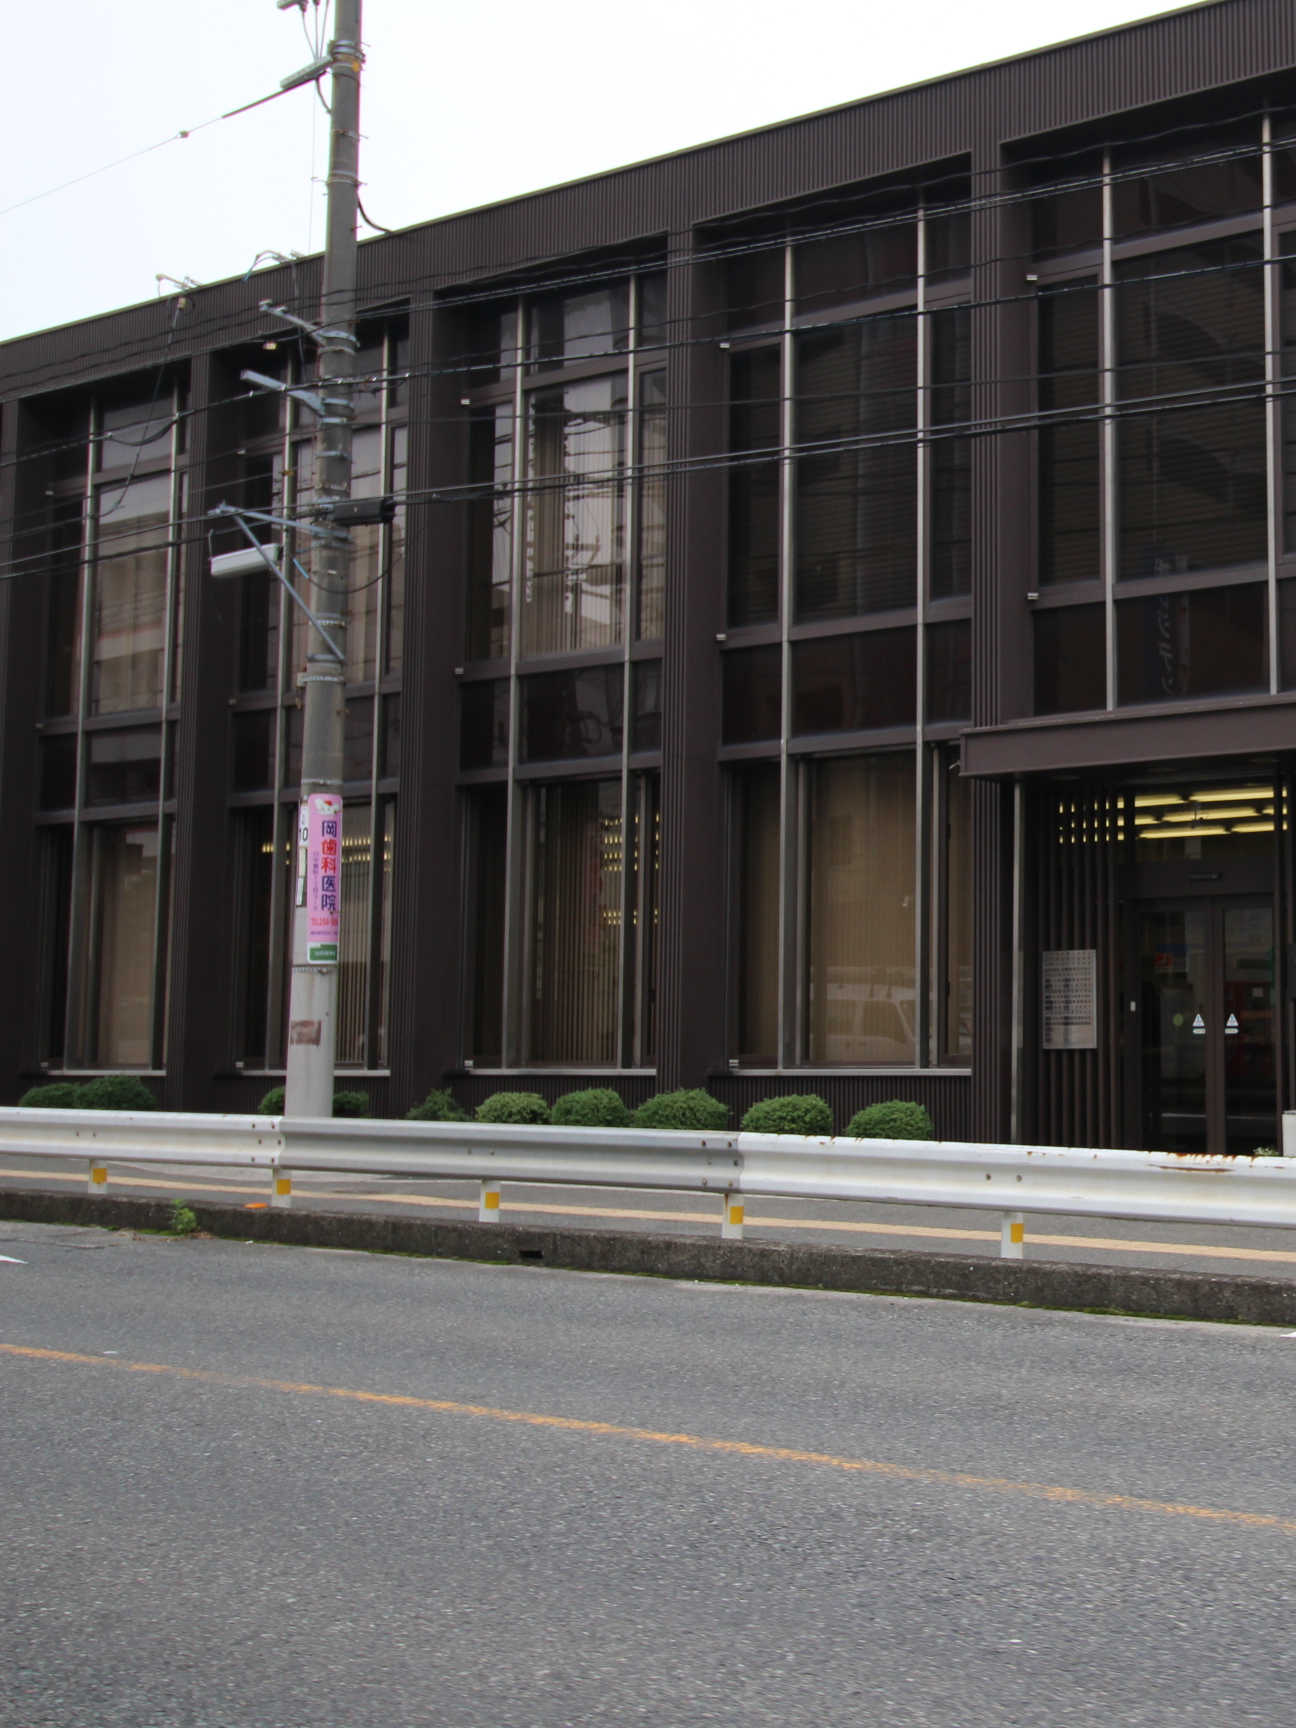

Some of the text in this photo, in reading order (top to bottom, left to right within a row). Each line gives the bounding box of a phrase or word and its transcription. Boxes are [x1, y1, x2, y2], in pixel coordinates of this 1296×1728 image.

[321, 820, 338, 911] 岡歯科医院
